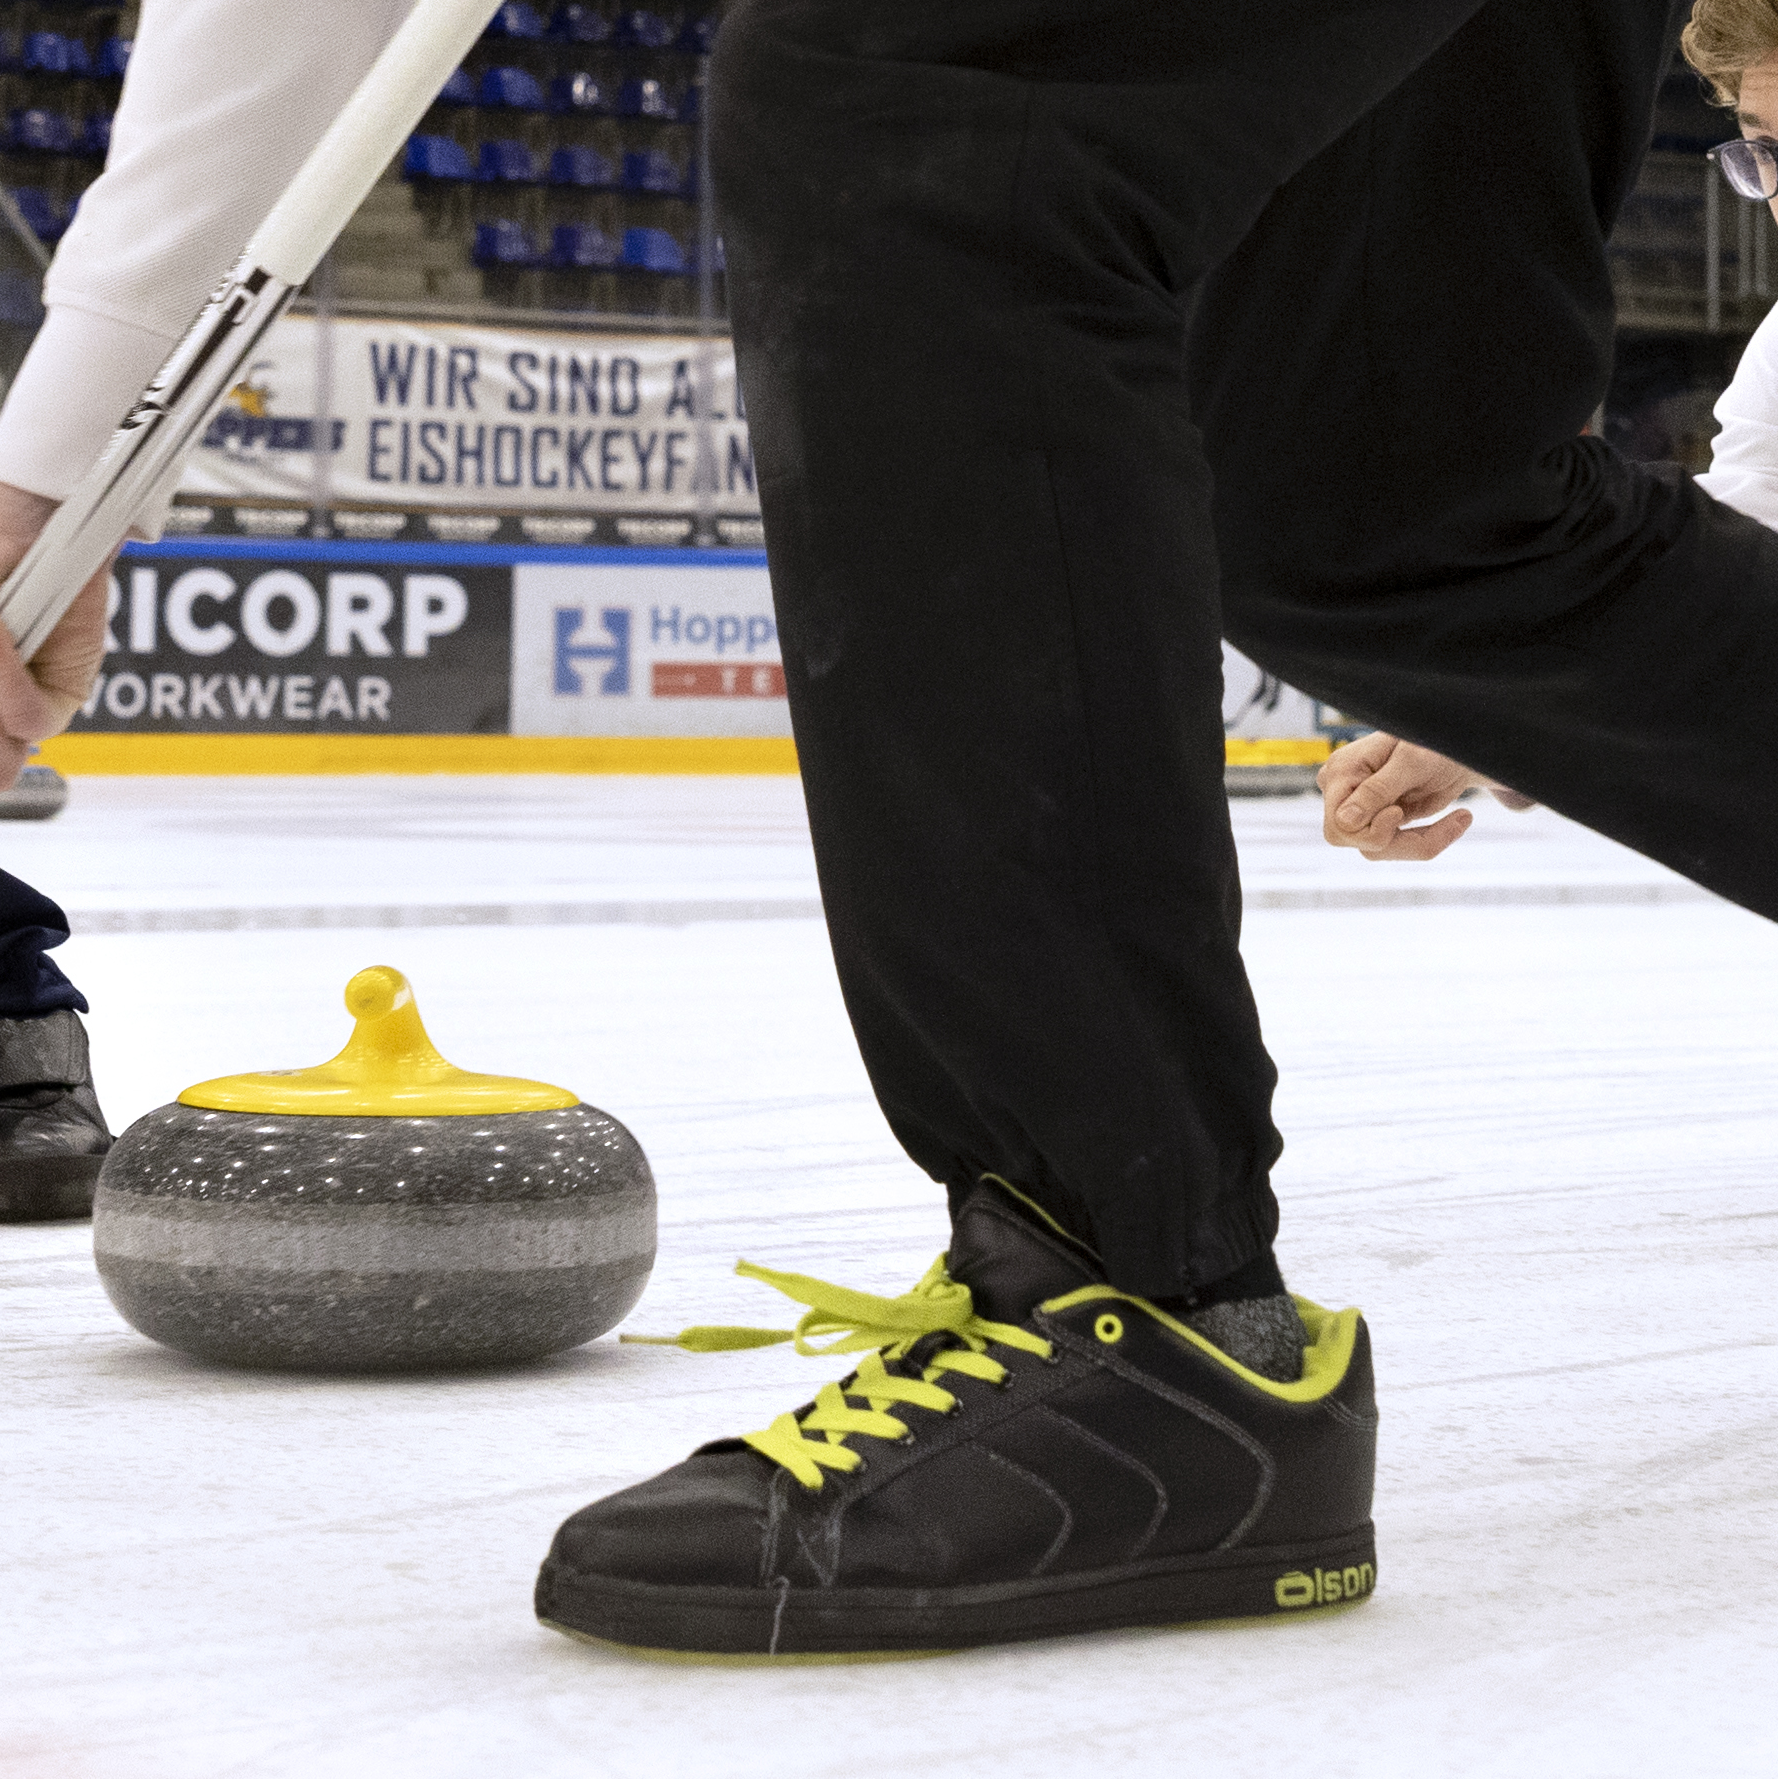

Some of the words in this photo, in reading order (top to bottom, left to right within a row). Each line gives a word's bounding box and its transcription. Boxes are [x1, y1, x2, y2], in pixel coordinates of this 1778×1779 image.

[369, 342, 478, 411] WIR
[509, 351, 640, 419] SIND
[104, 567, 469, 657] ICORP
[649, 604, 779, 654] Hopp
[1274, 1562, 1375, 1608] Olson
